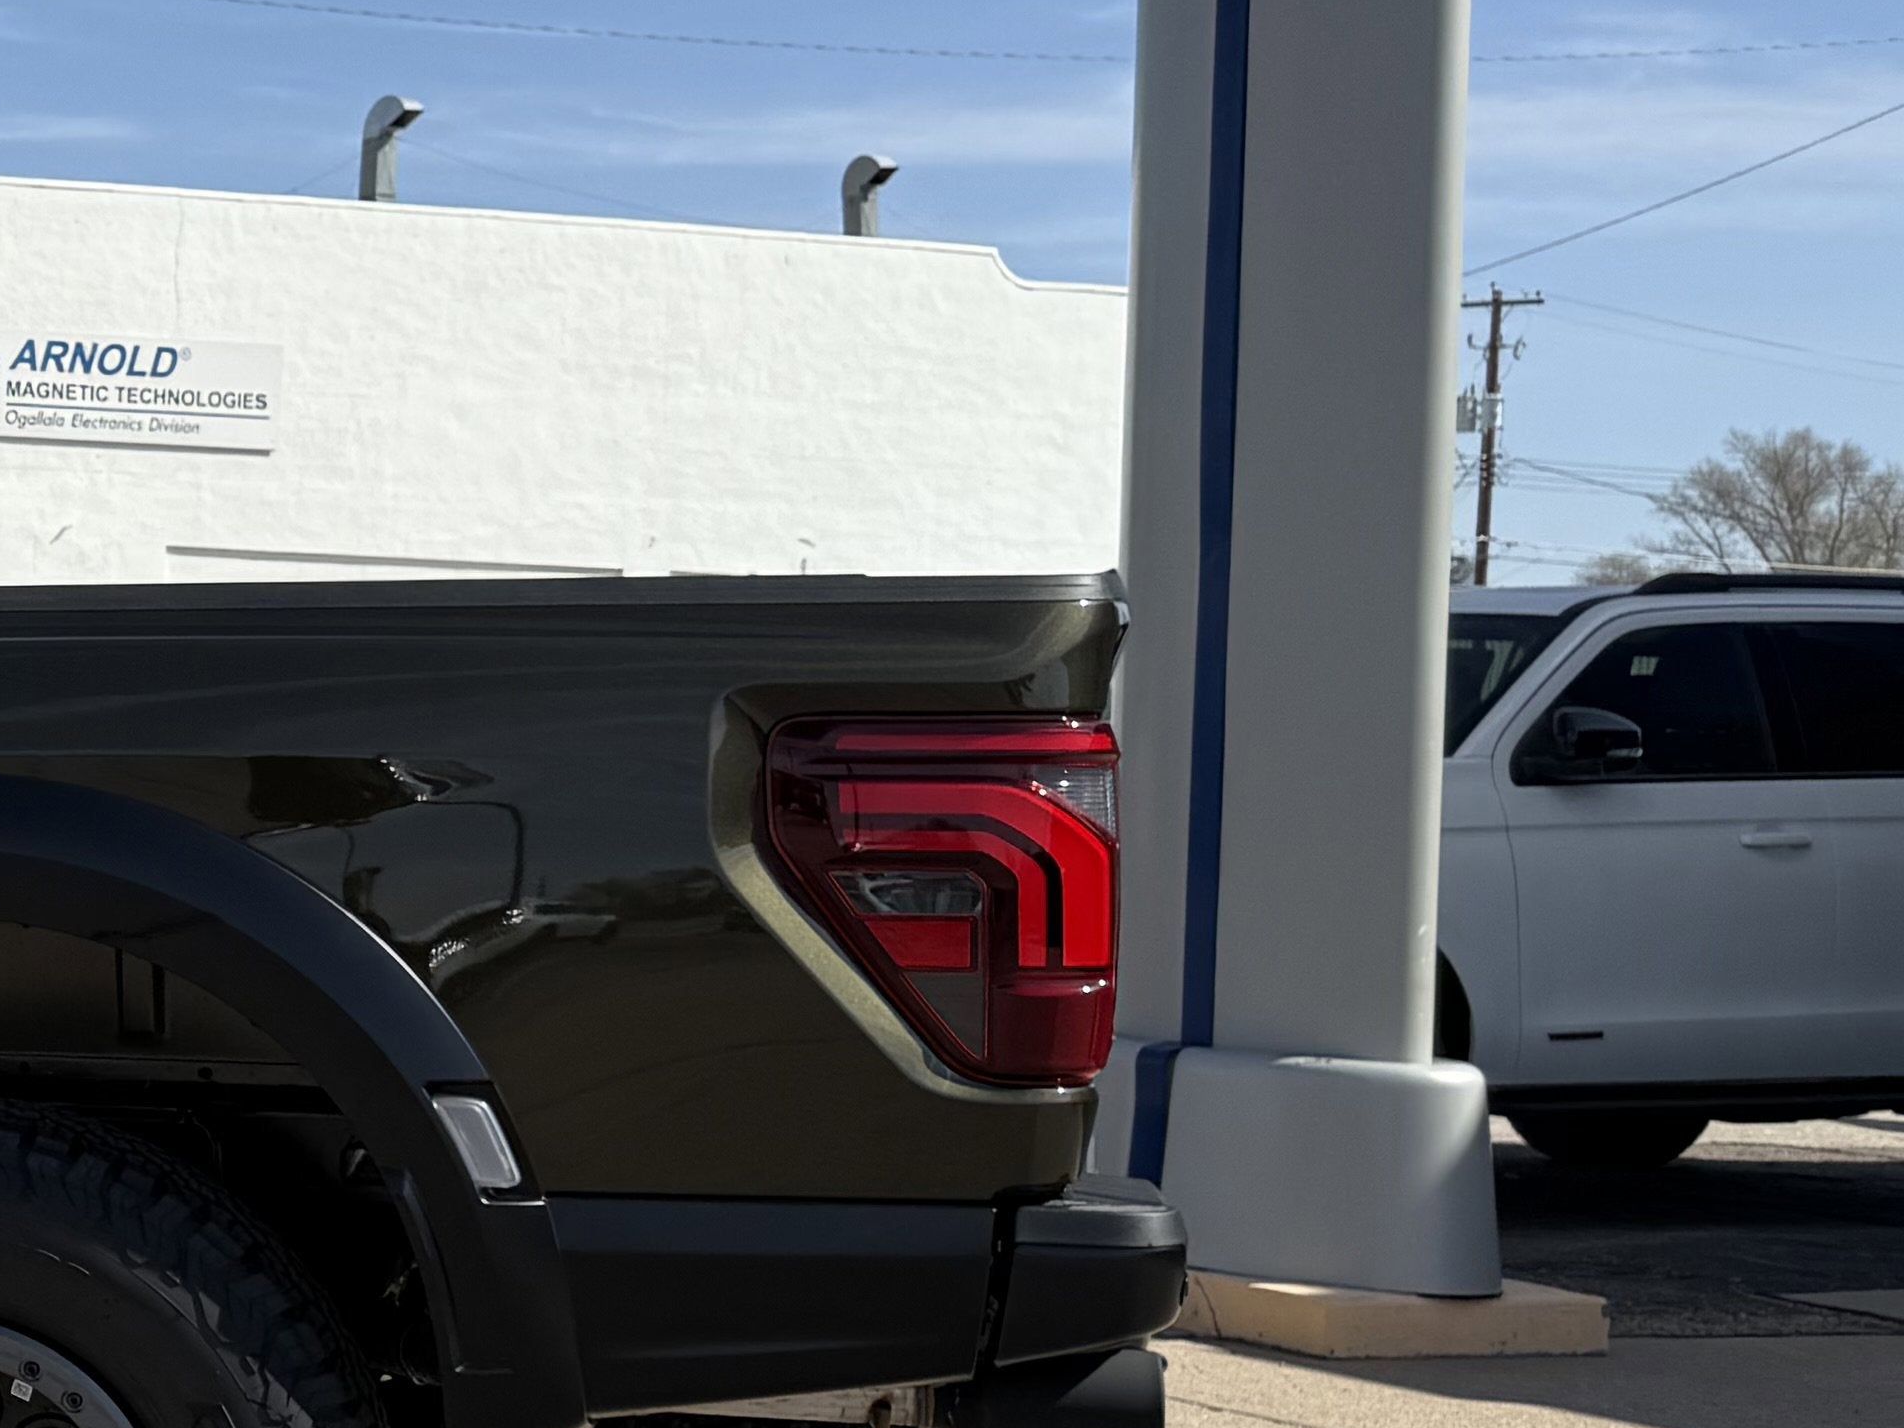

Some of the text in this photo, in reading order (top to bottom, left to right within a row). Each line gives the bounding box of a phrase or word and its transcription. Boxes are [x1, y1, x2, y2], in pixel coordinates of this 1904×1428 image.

[9, 338, 179, 378] ARNOLD
[5, 380, 269, 410] MAGNETIC TECHNOLOGIES
[4, 409, 200, 434] Ogallala Electronics Division
